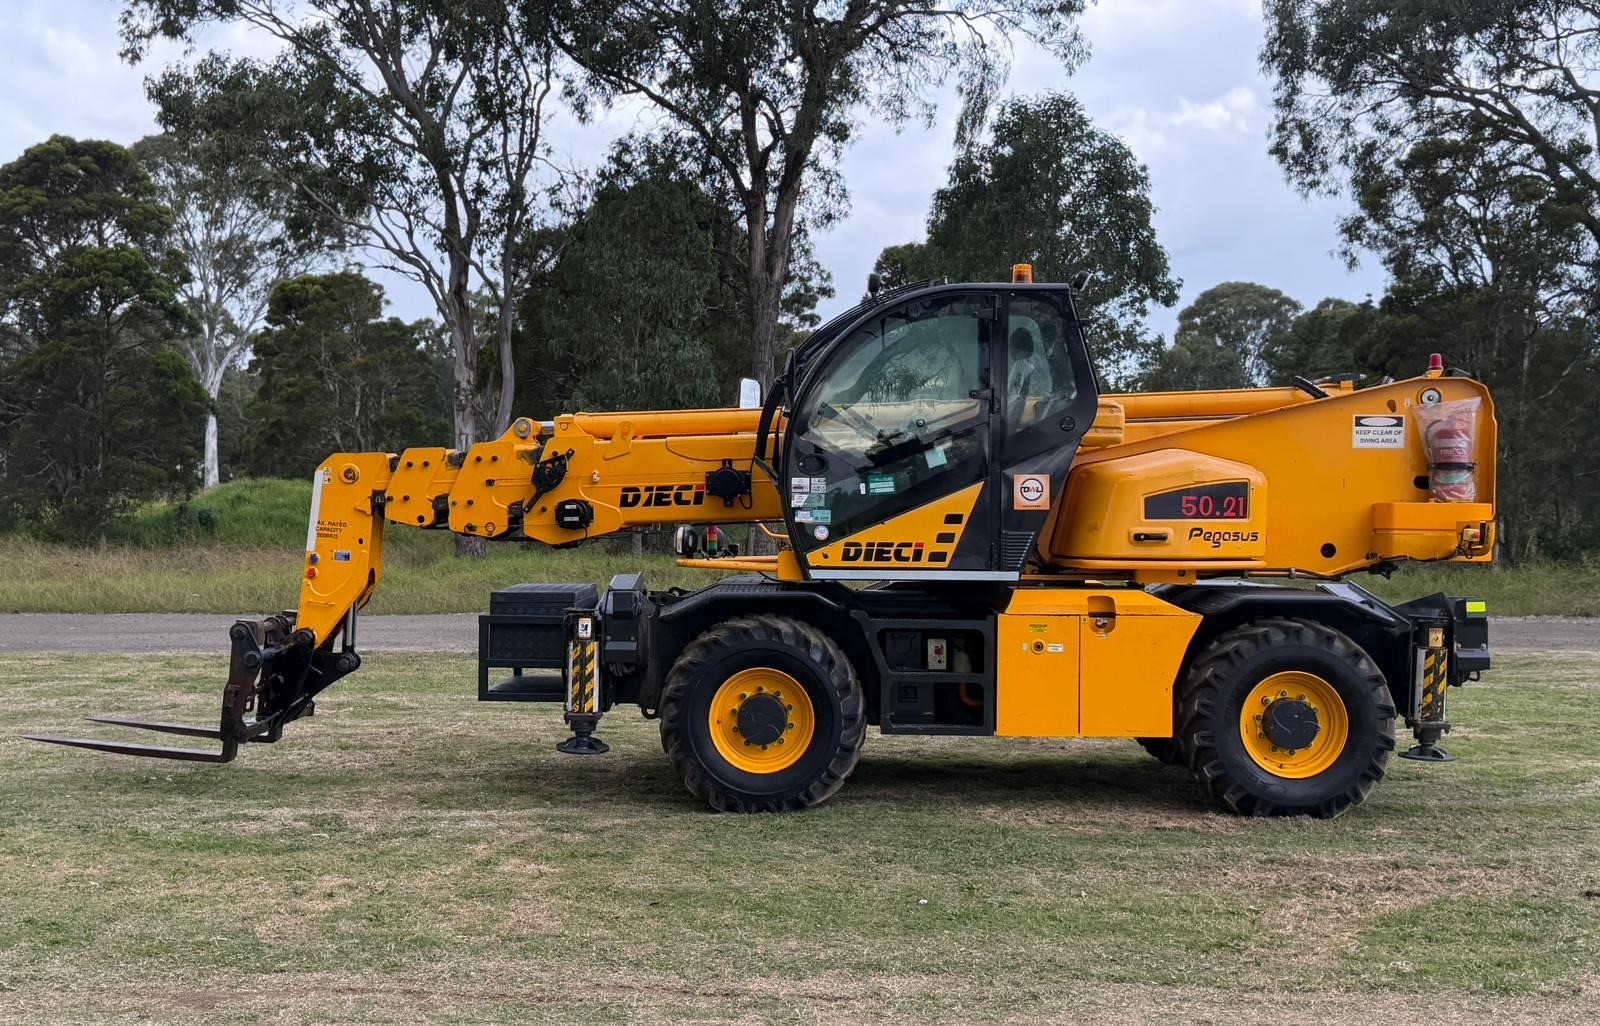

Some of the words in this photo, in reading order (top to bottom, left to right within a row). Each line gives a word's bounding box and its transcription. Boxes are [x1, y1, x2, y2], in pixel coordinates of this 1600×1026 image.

[619, 485, 705, 508] DIECI
[1181, 495, 1245, 517] 50.21
[315, 525, 343, 533] CAPACITY
[327, 520, 348, 528] RATED
[1188, 527, 1259, 548] Pegasus
[841, 541, 925, 562] DIECI
